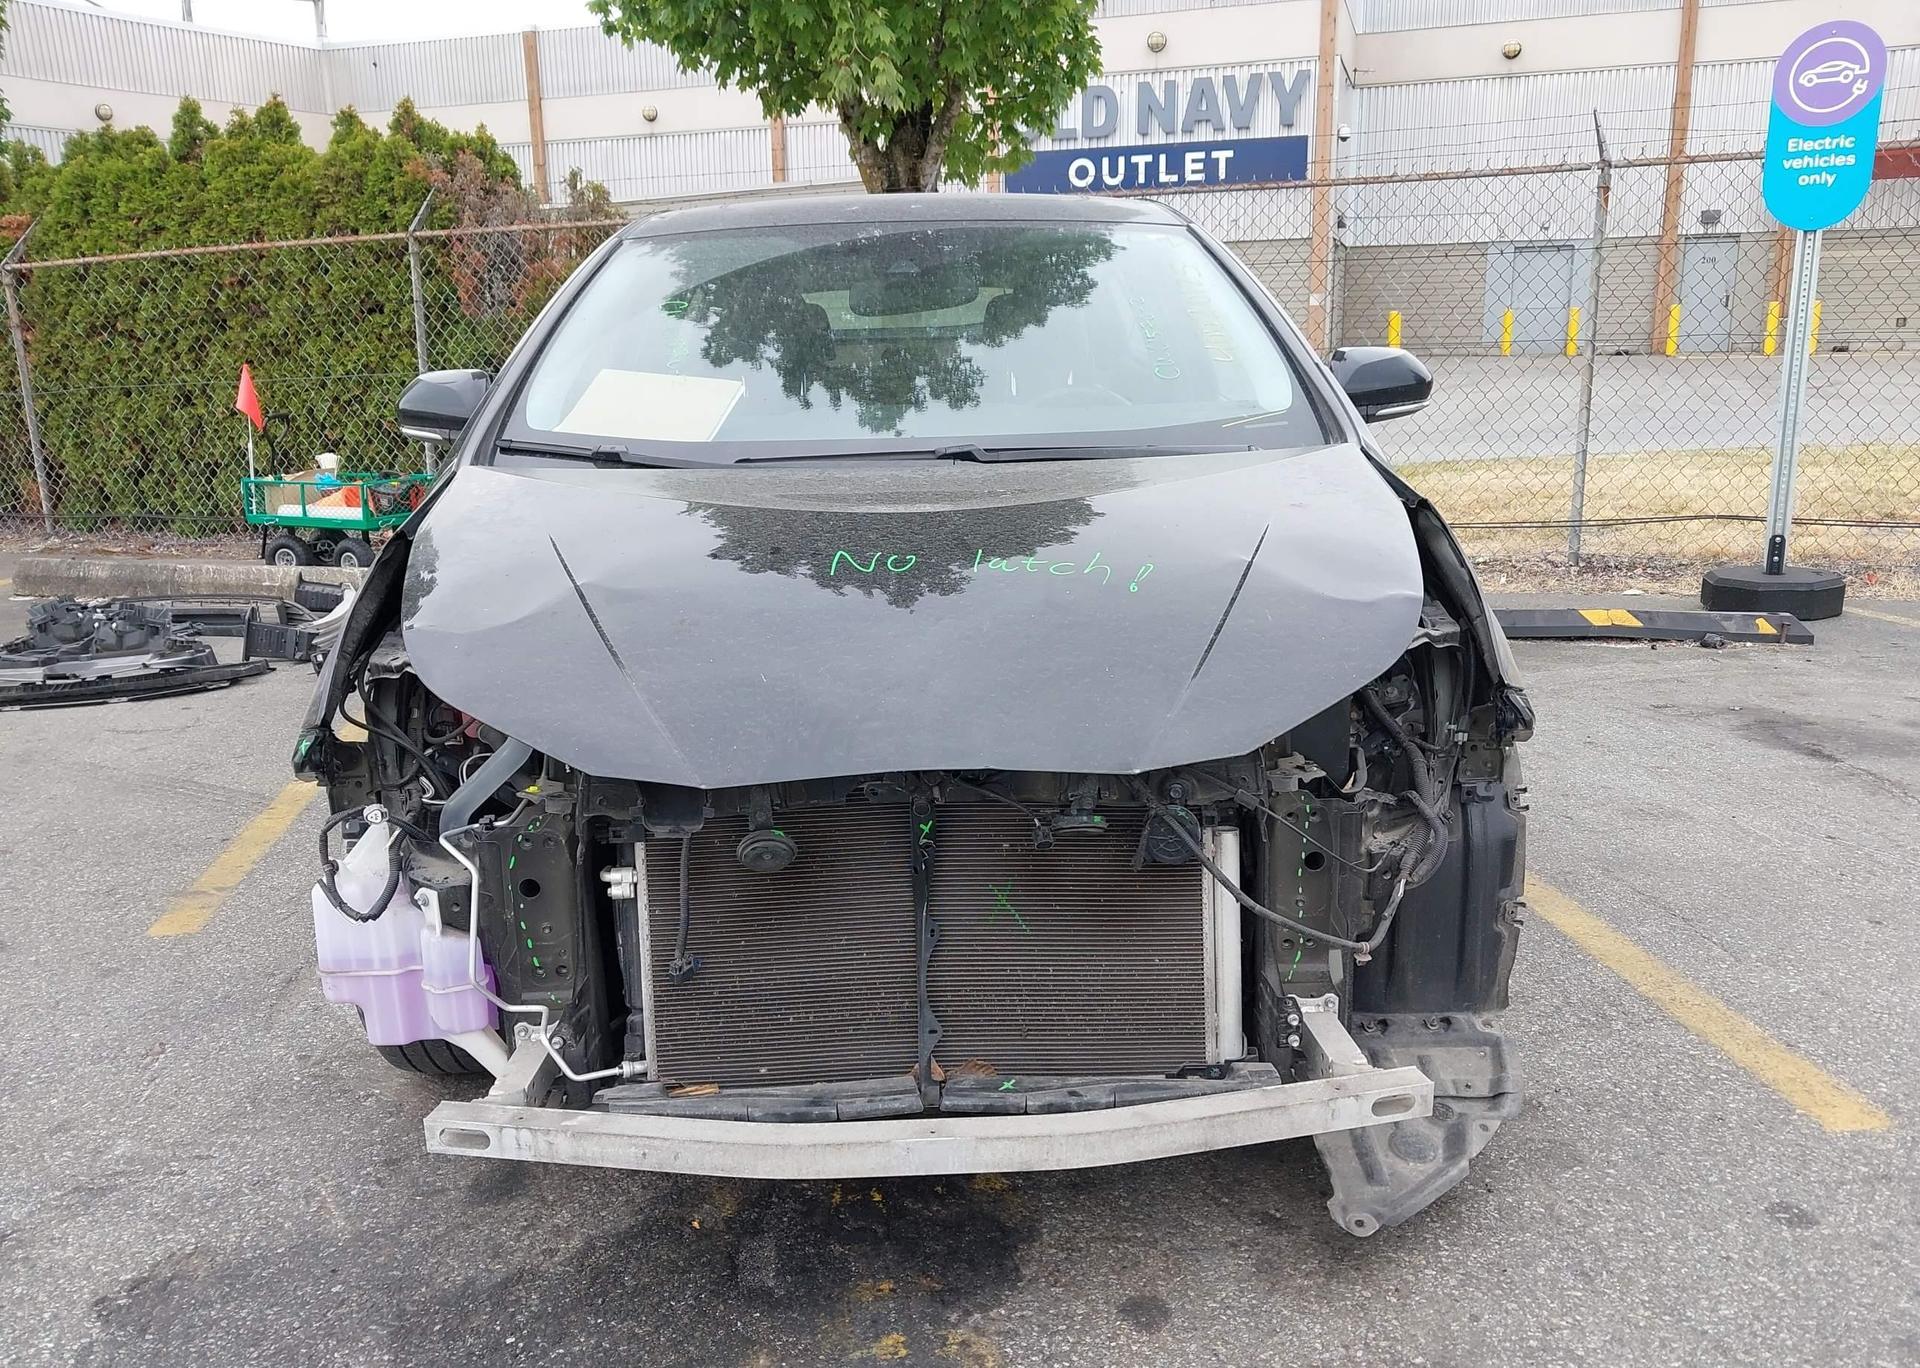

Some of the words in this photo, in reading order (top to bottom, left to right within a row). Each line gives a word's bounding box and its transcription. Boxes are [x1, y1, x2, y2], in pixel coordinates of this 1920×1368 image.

[1022, 85, 1119, 141] LD
[1137, 69, 1311, 136] NAVY
[1787, 134, 1856, 153] Electric
[1068, 149, 1234, 188] OUTLET
[1782, 153, 1856, 170] vehicles
[1798, 171, 1837, 188] only
